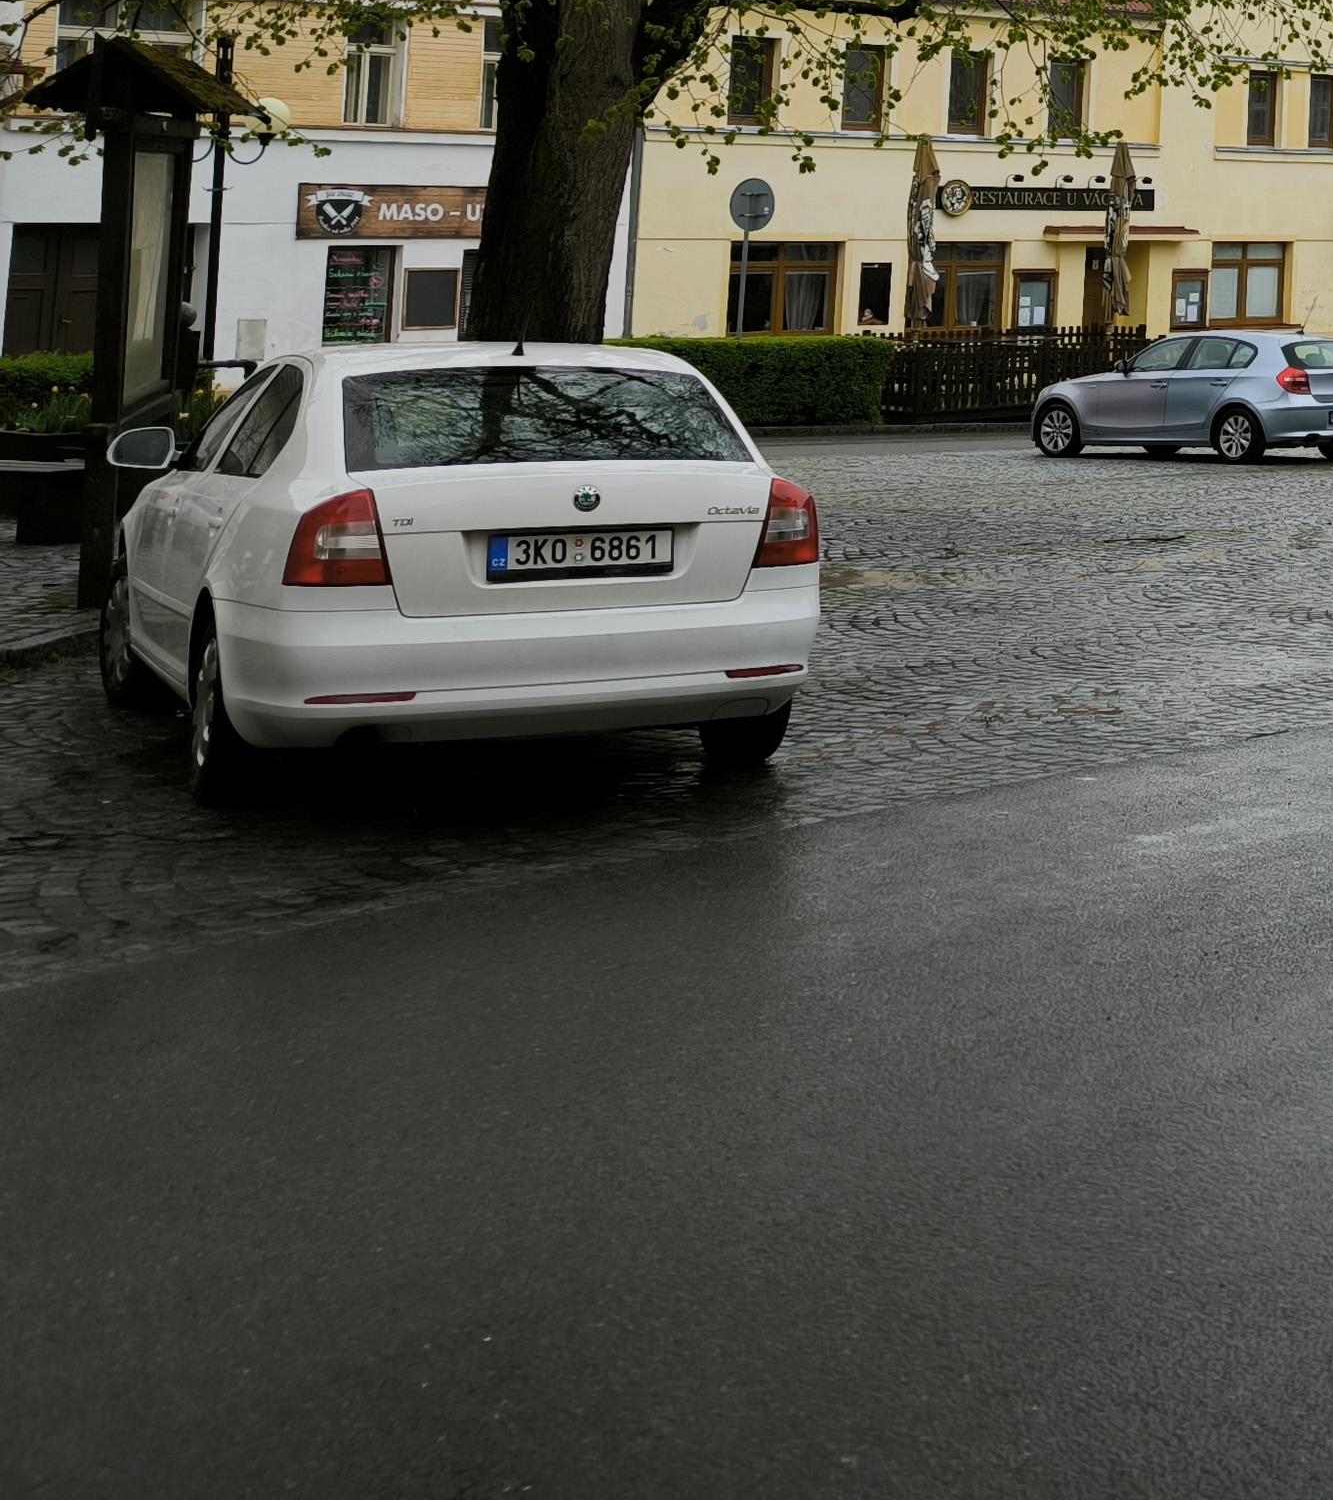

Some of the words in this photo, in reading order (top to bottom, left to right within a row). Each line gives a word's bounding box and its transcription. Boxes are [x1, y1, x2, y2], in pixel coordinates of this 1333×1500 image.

[971, 190, 1061, 206] RESTAURACE
[1067, 192, 1077, 206] U
[378, 203, 444, 222] MASO
[466, 204, 485, 222] U
[707, 505, 760, 516] Octavia
[515, 539, 567, 566] 3K0
[590, 534, 657, 563] 6861
[491, 557, 506, 568] CZ
